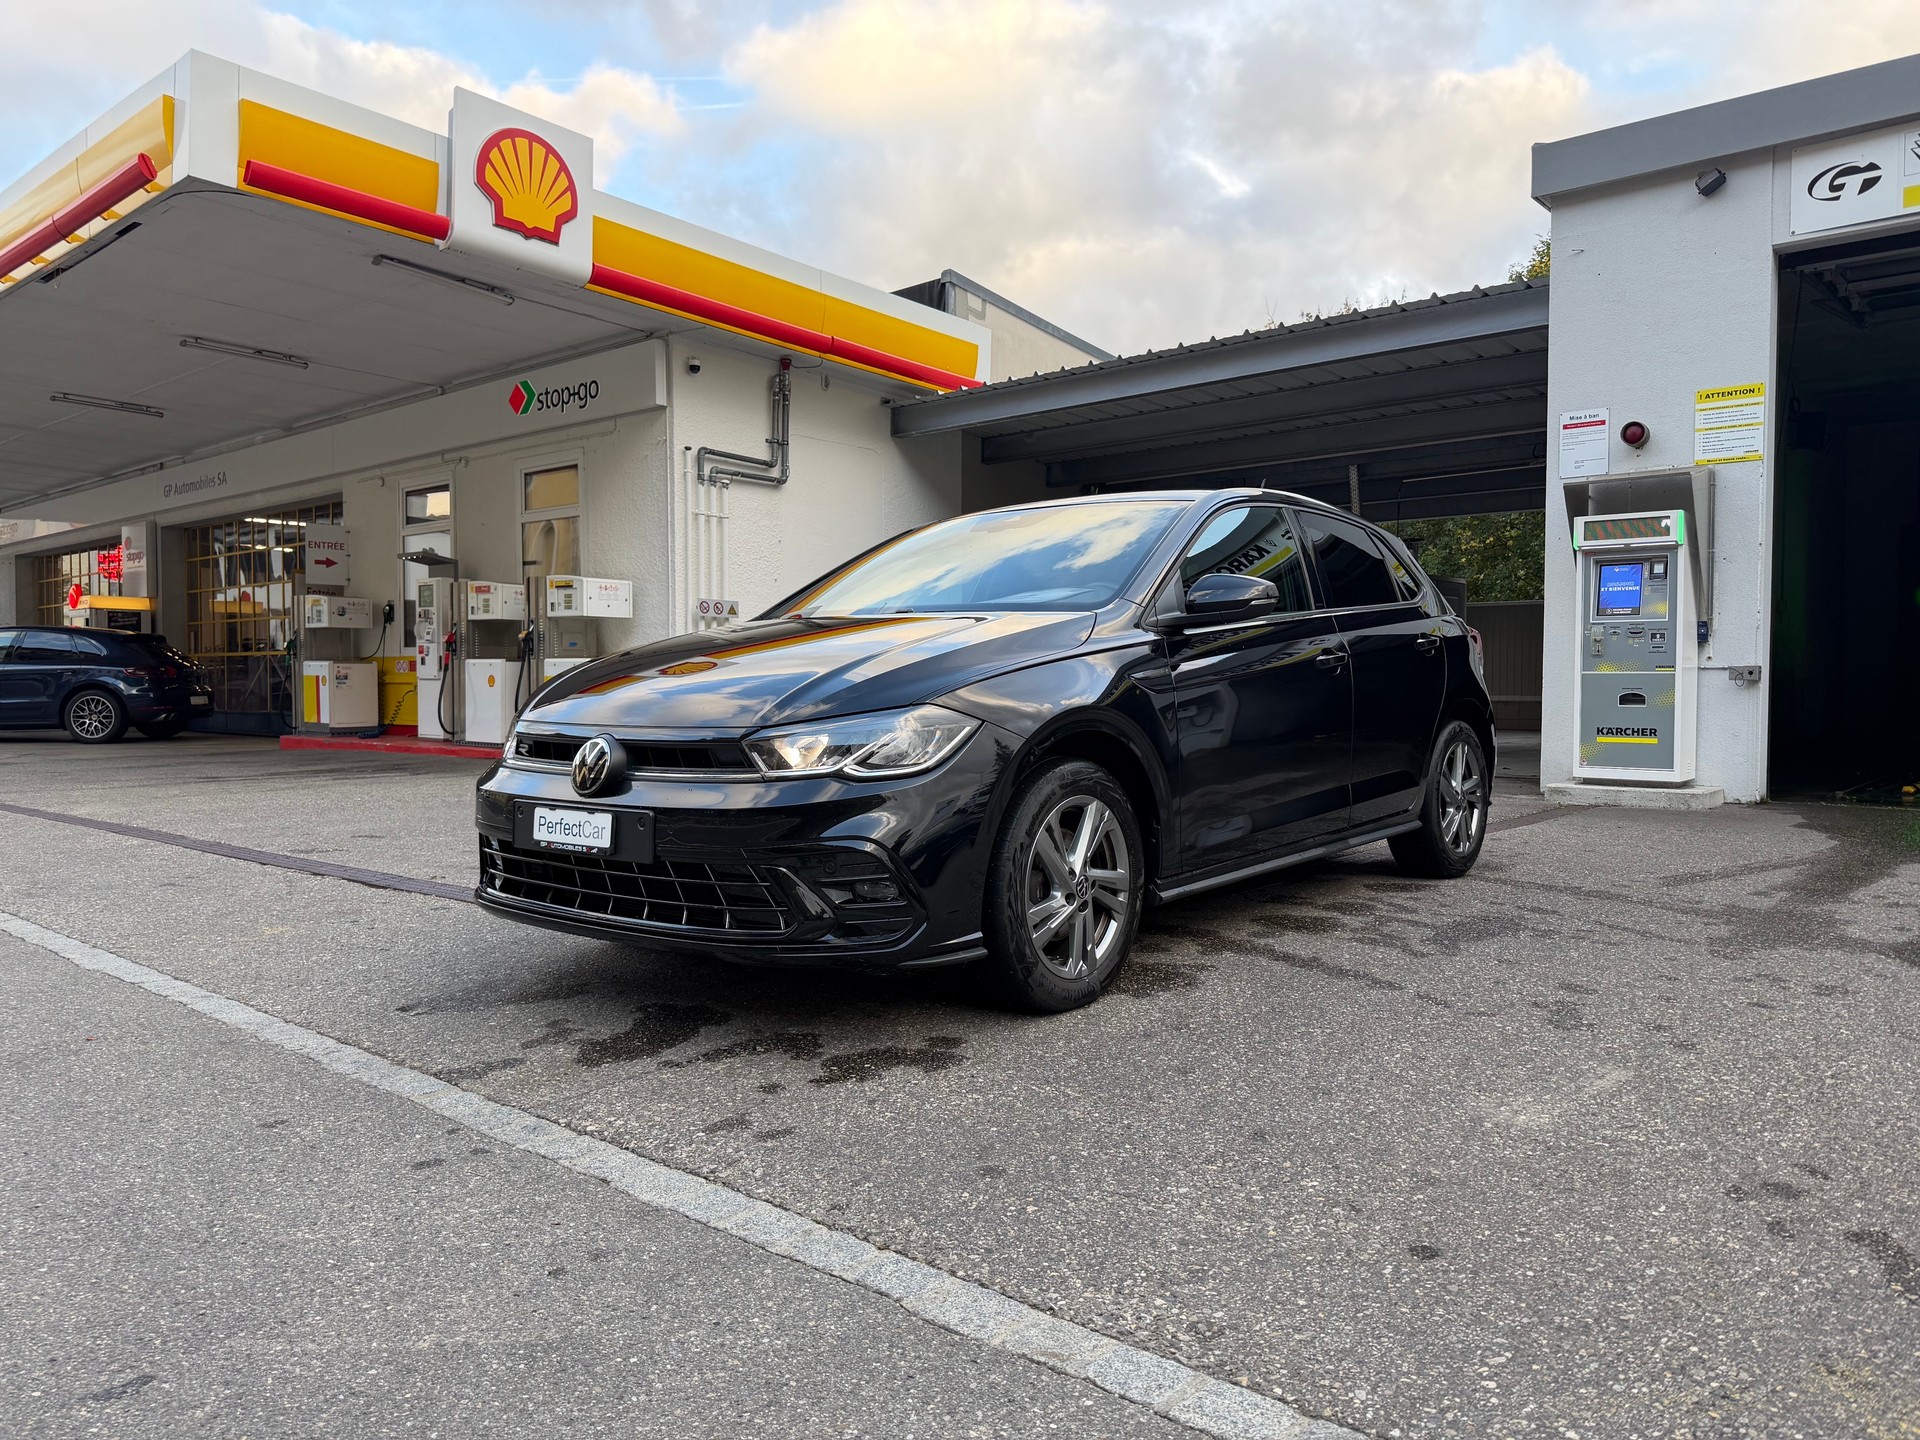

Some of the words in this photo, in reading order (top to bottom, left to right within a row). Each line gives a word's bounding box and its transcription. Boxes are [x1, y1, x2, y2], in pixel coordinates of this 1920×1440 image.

[537, 380, 599, 413] stop+go
[1704, 388, 1755, 400] ATTENTION
[164, 484, 172, 498] GP
[174, 474, 215, 496] Automobiles
[218, 471, 227, 486] SA
[308, 540, 345, 550] ENTRÉE
[1597, 727, 1658, 736] KÄRCHER
[538, 816, 606, 840] PerfectCar
